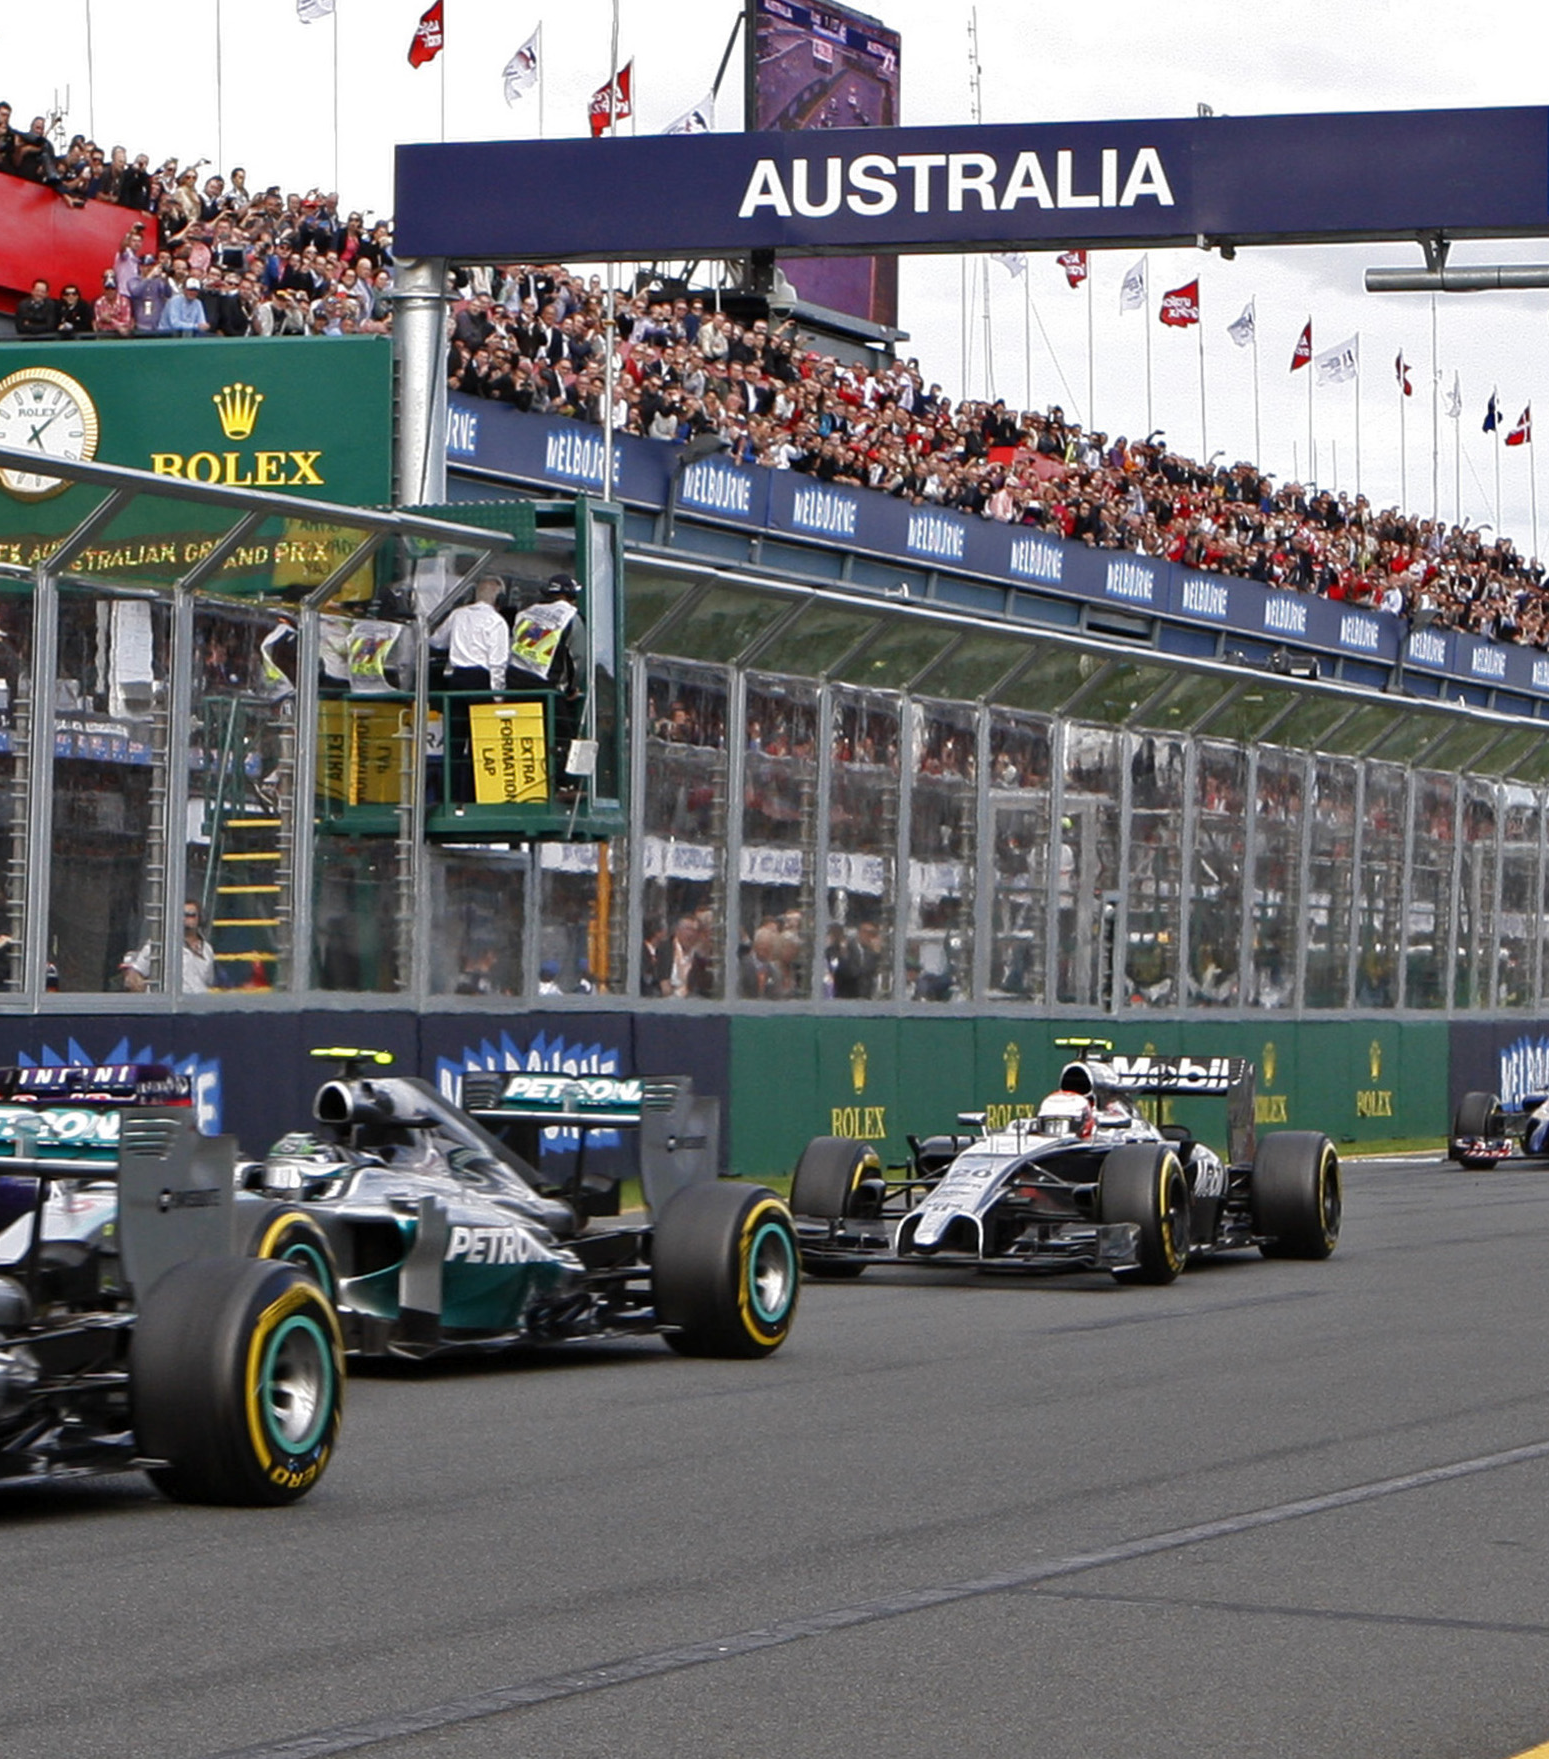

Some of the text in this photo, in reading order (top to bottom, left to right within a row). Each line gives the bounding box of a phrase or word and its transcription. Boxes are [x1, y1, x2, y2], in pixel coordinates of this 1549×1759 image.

[739, 148, 1174, 218] AUSTRALIA
[152, 450, 325, 487] ROLEX
[546, 435, 621, 483] MELBOURE
[683, 469, 749, 511] MELBOURNE
[794, 489, 856, 535] MELBOURNE
[273, 541, 328, 564] PRIX
[908, 517, 964, 558] MELBOURNE
[1011, 541, 1063, 580] MELBOURNE
[482, 747, 497, 777] LAP
[520, 736, 537, 785] EXTRA
[1112, 1056, 1230, 1088] Mobil
[831, 1106, 886, 1140] ROLEX
[1357, 1090, 1392, 1117] ROLEX
